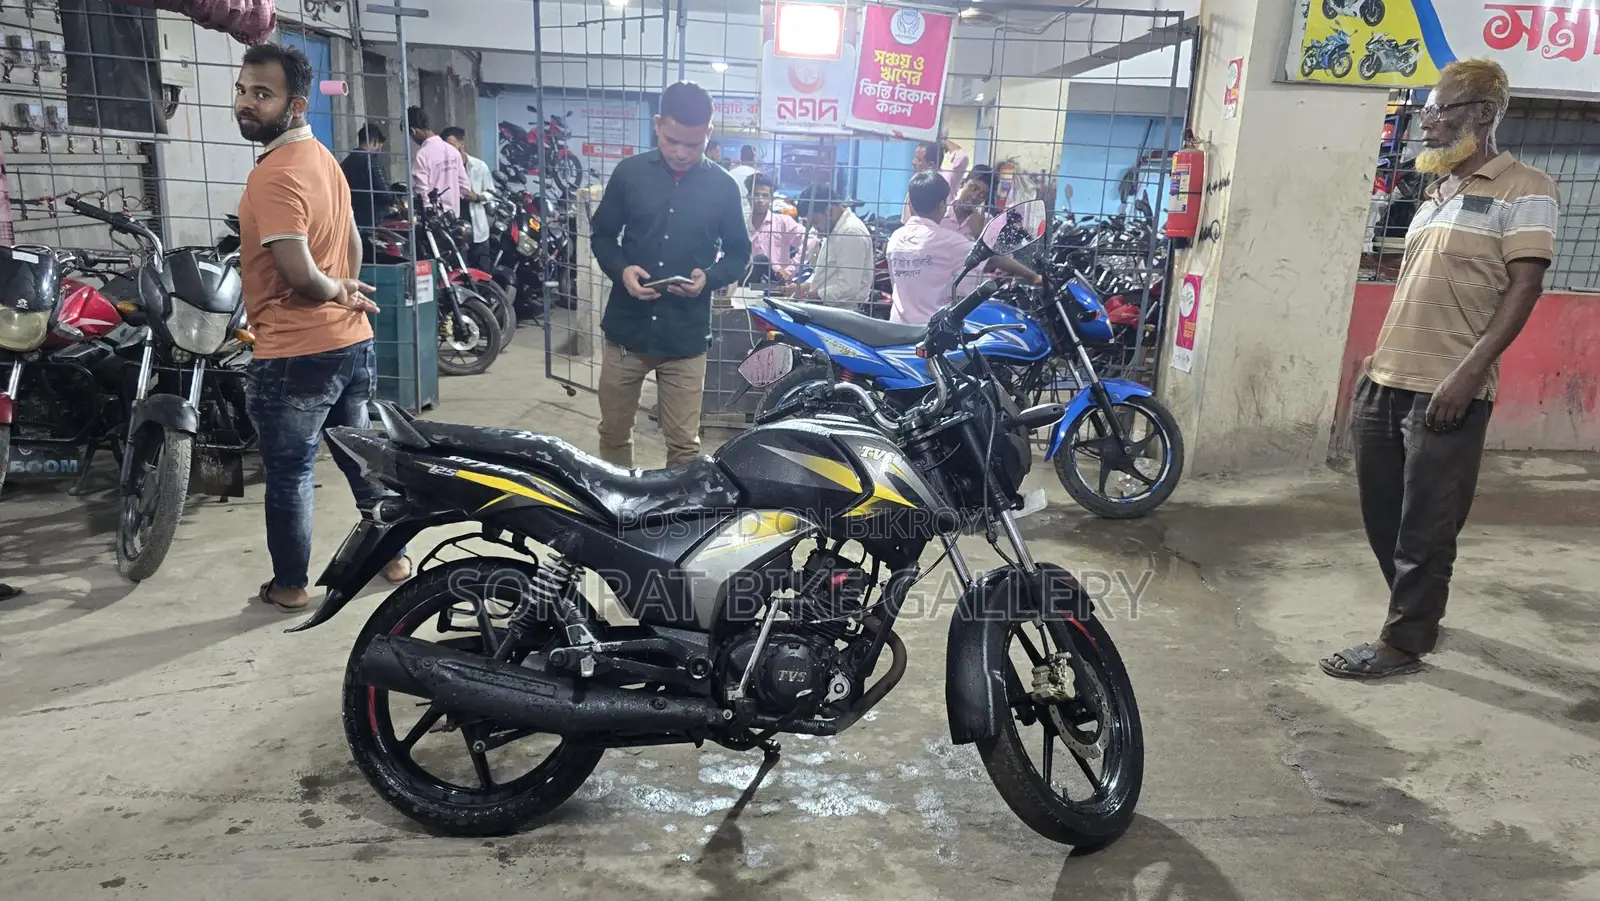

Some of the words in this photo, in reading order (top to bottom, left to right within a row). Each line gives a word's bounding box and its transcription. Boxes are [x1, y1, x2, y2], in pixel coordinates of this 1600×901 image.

[873, 49, 912, 69] সঞ্চয়
[913, 56, 925, 71] ও
[880, 66, 923, 86] ঋণের
[859, 79, 893, 99] কিস্তি
[894, 83, 936, 105] বিকাশ
[777, 96, 839, 122] নগদ
[875, 99, 914, 117] করুন
[860, 445, 896, 464] TVS
[428, 464, 457, 477] 125
[777, 669, 808, 683] TVS
